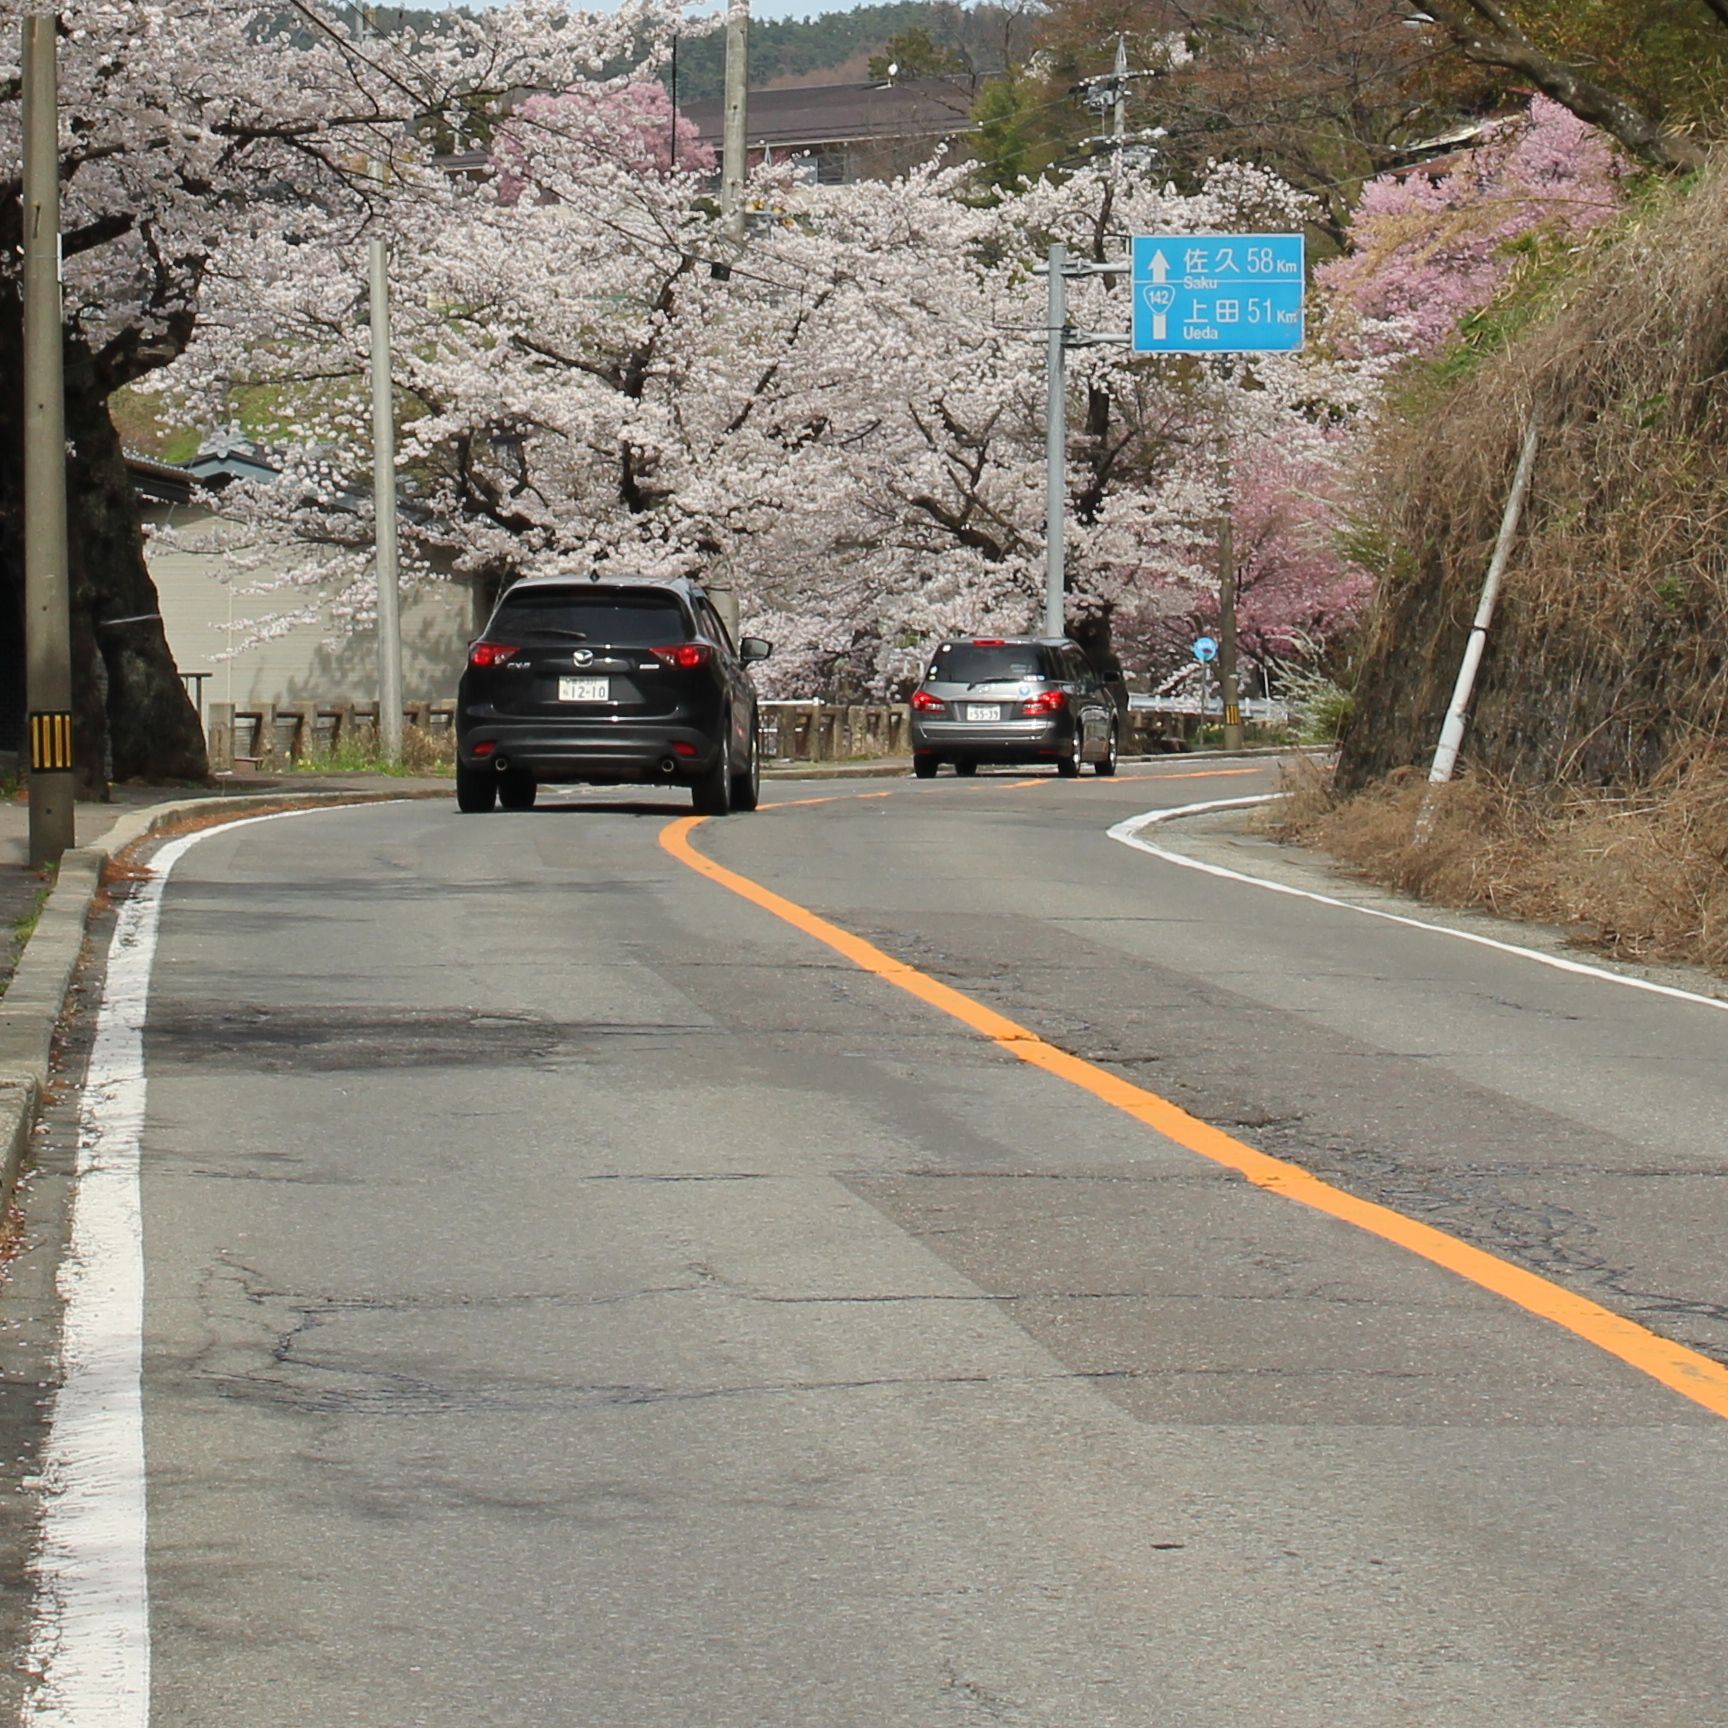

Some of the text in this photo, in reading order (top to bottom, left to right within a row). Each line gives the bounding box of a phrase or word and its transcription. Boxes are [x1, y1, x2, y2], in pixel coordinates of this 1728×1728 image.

[1183, 248, 1240, 273] 佐久
[1247, 247, 1273, 273] 58
[1183, 276, 1218, 290] Saku
[1149, 290, 1169, 305] 142
[1183, 298, 1240, 323] 上田
[1247, 297, 1272, 323] 51
[1183, 326, 1218, 340] Ueda
[571, 686, 606, 699] 12-10
